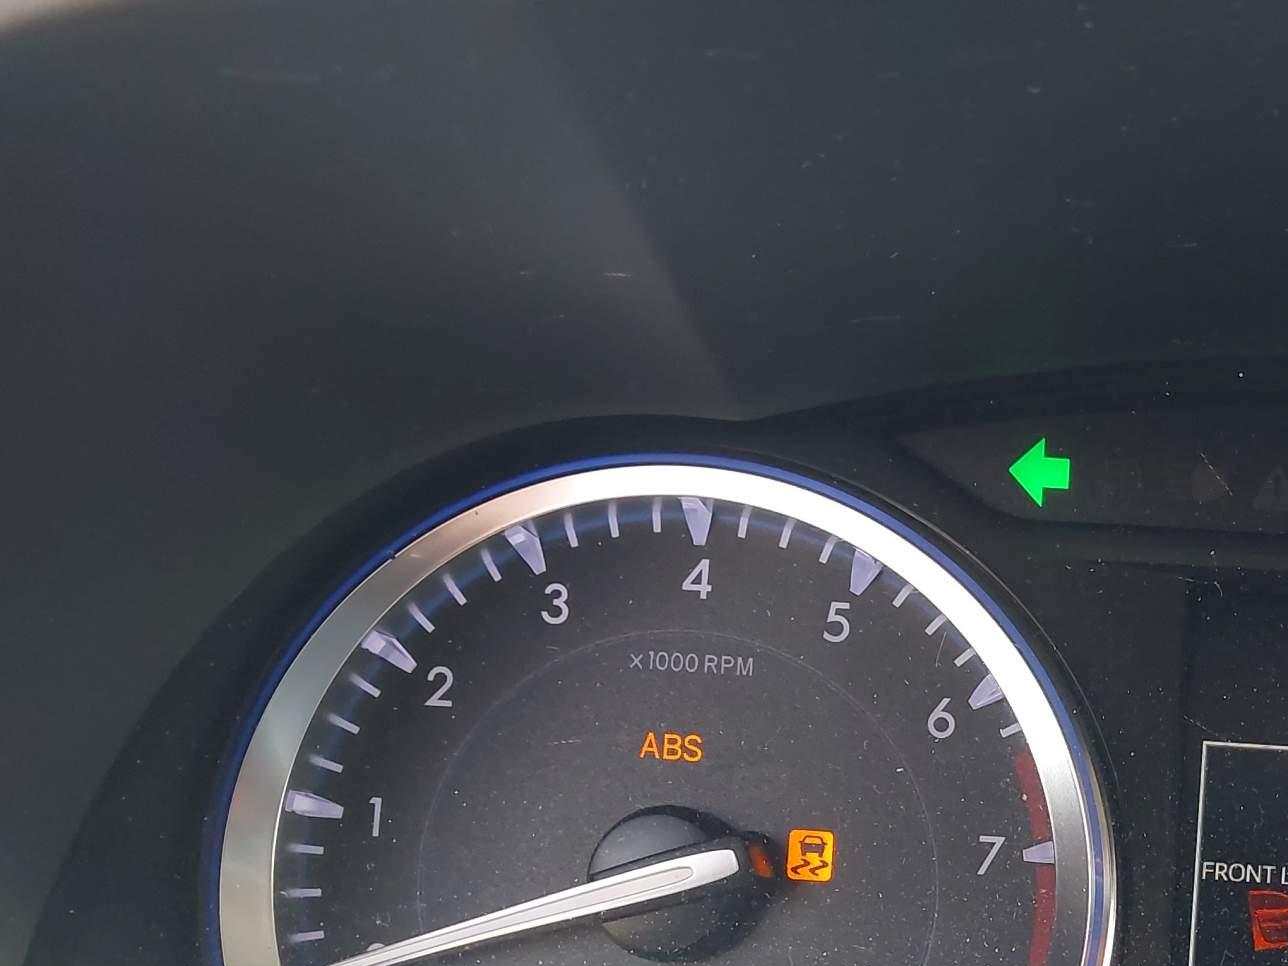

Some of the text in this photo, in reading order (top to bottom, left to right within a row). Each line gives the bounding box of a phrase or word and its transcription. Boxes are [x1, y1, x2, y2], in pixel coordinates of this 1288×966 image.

[681, 558, 712, 600] 4
[541, 583, 569, 625] 3
[823, 601, 850, 643] 5
[704, 654, 754, 677] RPM
[423, 665, 454, 708] 2
[927, 697, 956, 739] 6
[639, 732, 702, 762] ABS
[369, 796, 382, 837] 1
[977, 835, 1006, 875] 7
[1202, 861, 1276, 884] FRONT
